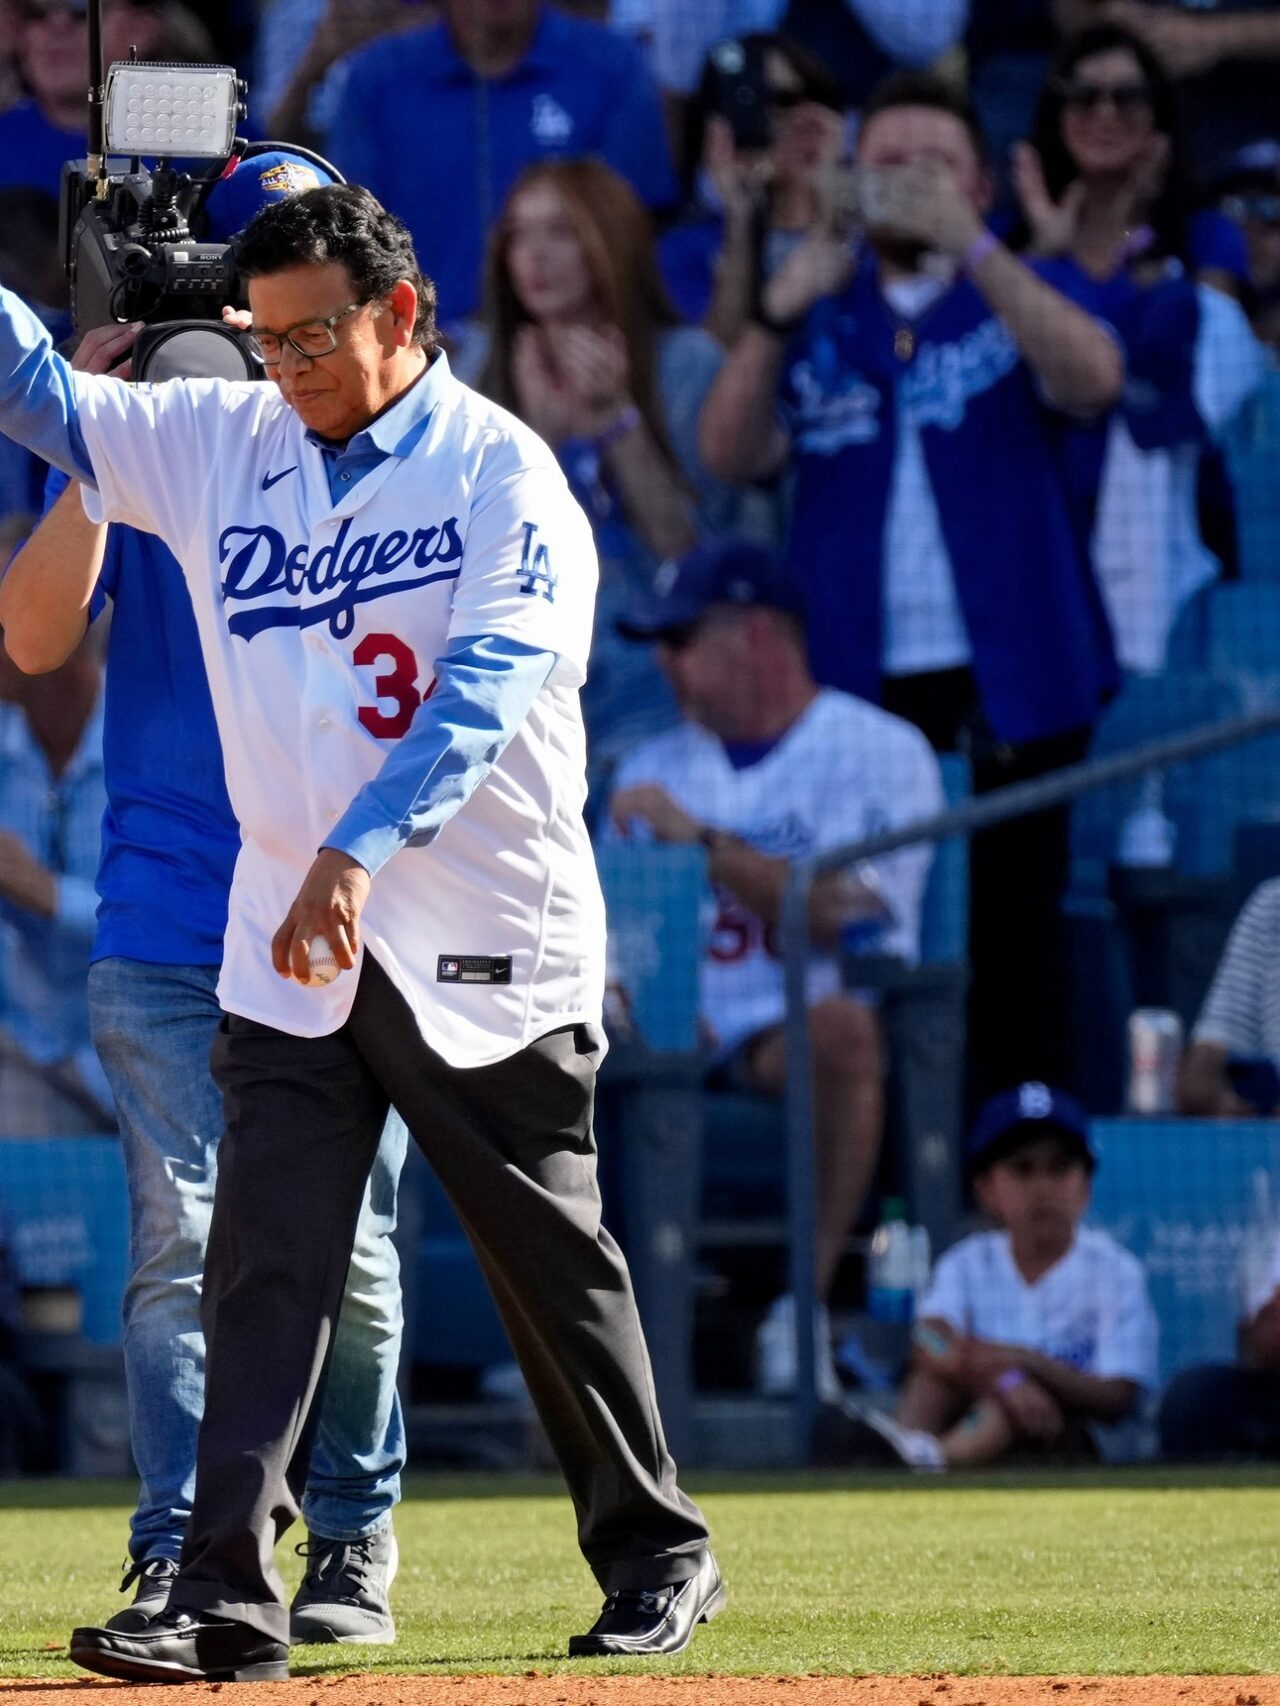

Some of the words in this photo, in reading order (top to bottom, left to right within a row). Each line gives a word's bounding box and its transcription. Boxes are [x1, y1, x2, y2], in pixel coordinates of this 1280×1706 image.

[219, 516, 463, 640] Dodgers
[516, 521, 558, 604] LA
[352, 633, 439, 739] 3
